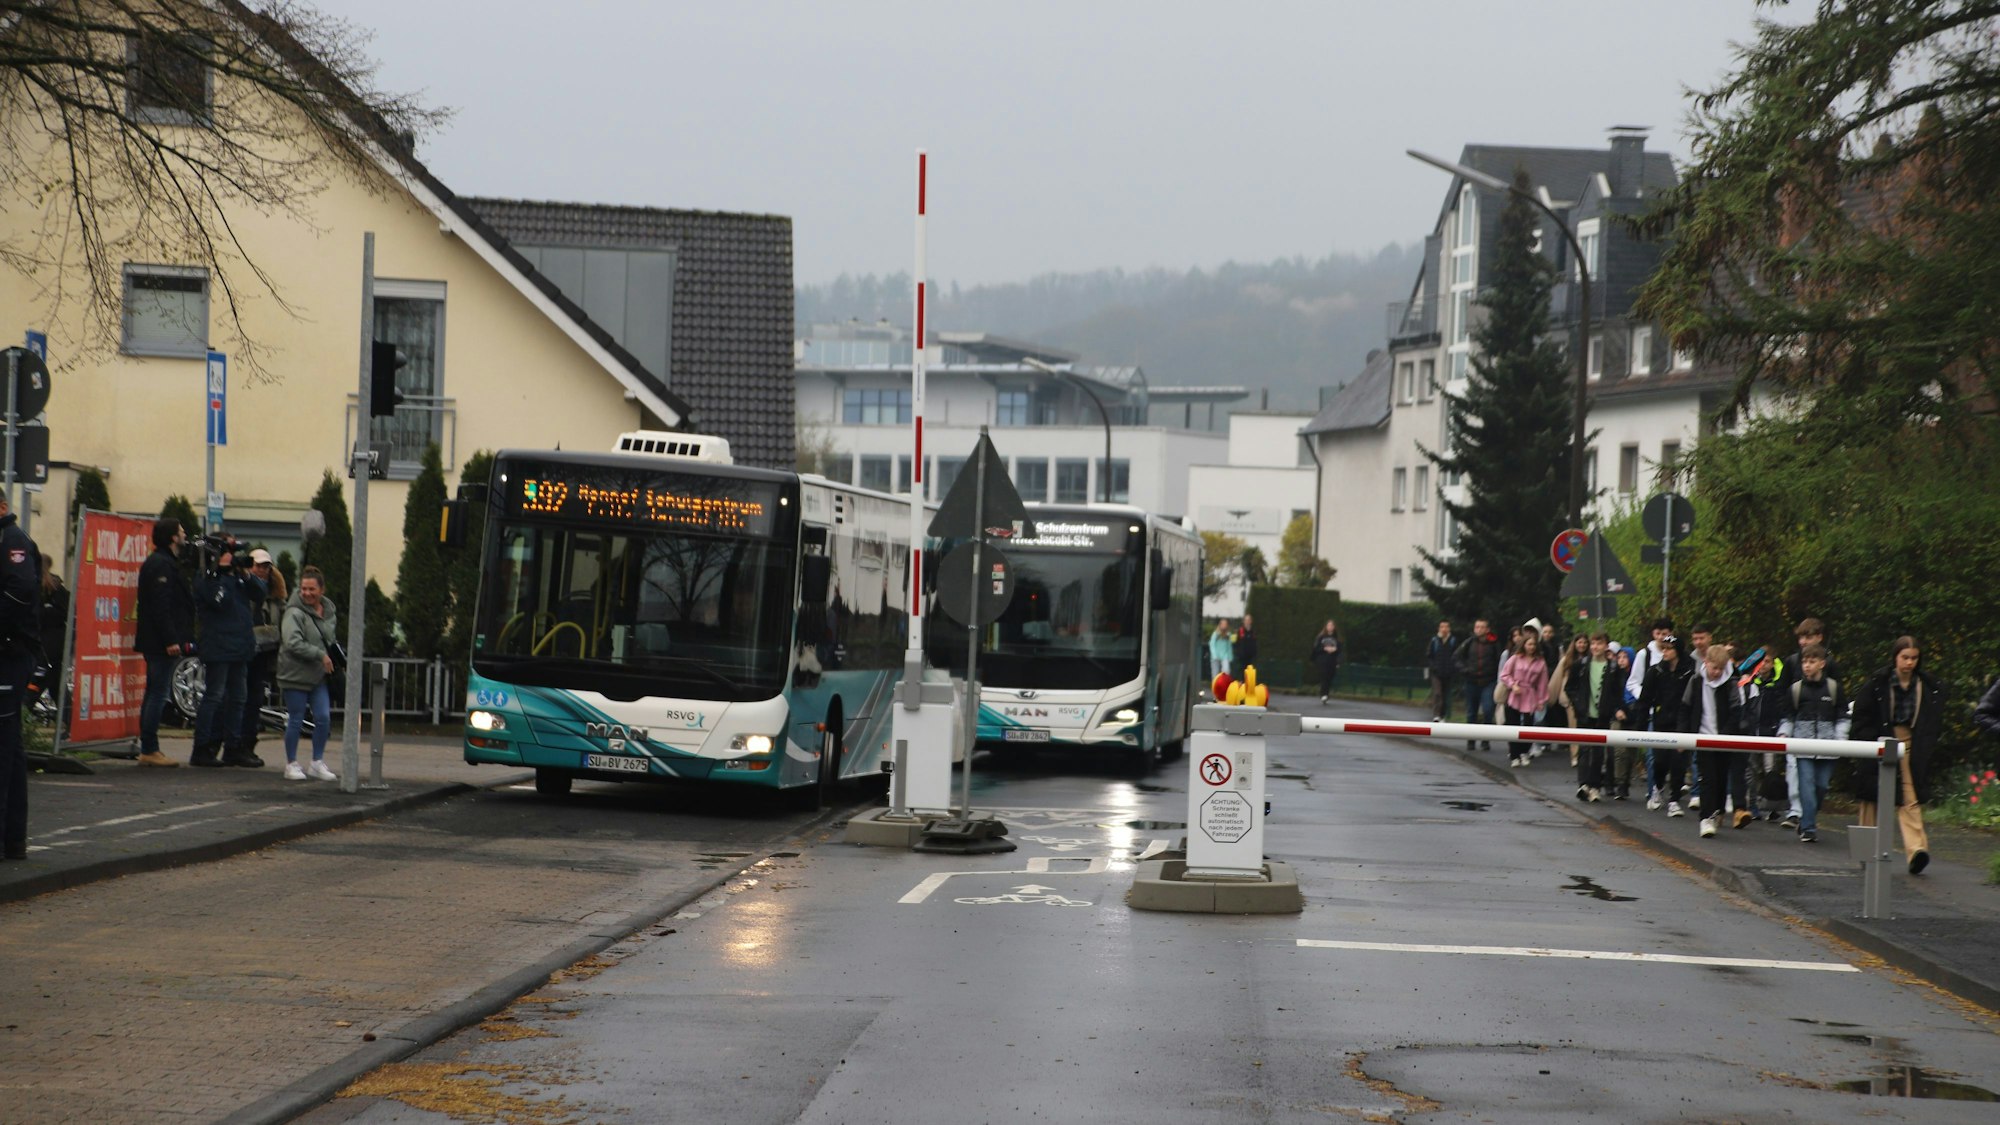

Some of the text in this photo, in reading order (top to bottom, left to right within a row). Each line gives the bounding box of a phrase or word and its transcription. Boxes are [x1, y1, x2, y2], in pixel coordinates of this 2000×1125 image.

[579, 483, 639, 505] Hennef
[1035, 521, 1110, 535] Schulzentrum
[666, 710, 695, 721] RSVG
[1004, 706, 1049, 717] MAN
[1058, 707, 1079, 715] RSVG
[586, 722, 649, 741] MAN
[1031, 731, 1048, 741] 2842
[588, 755, 648, 771] SU BV 2675
